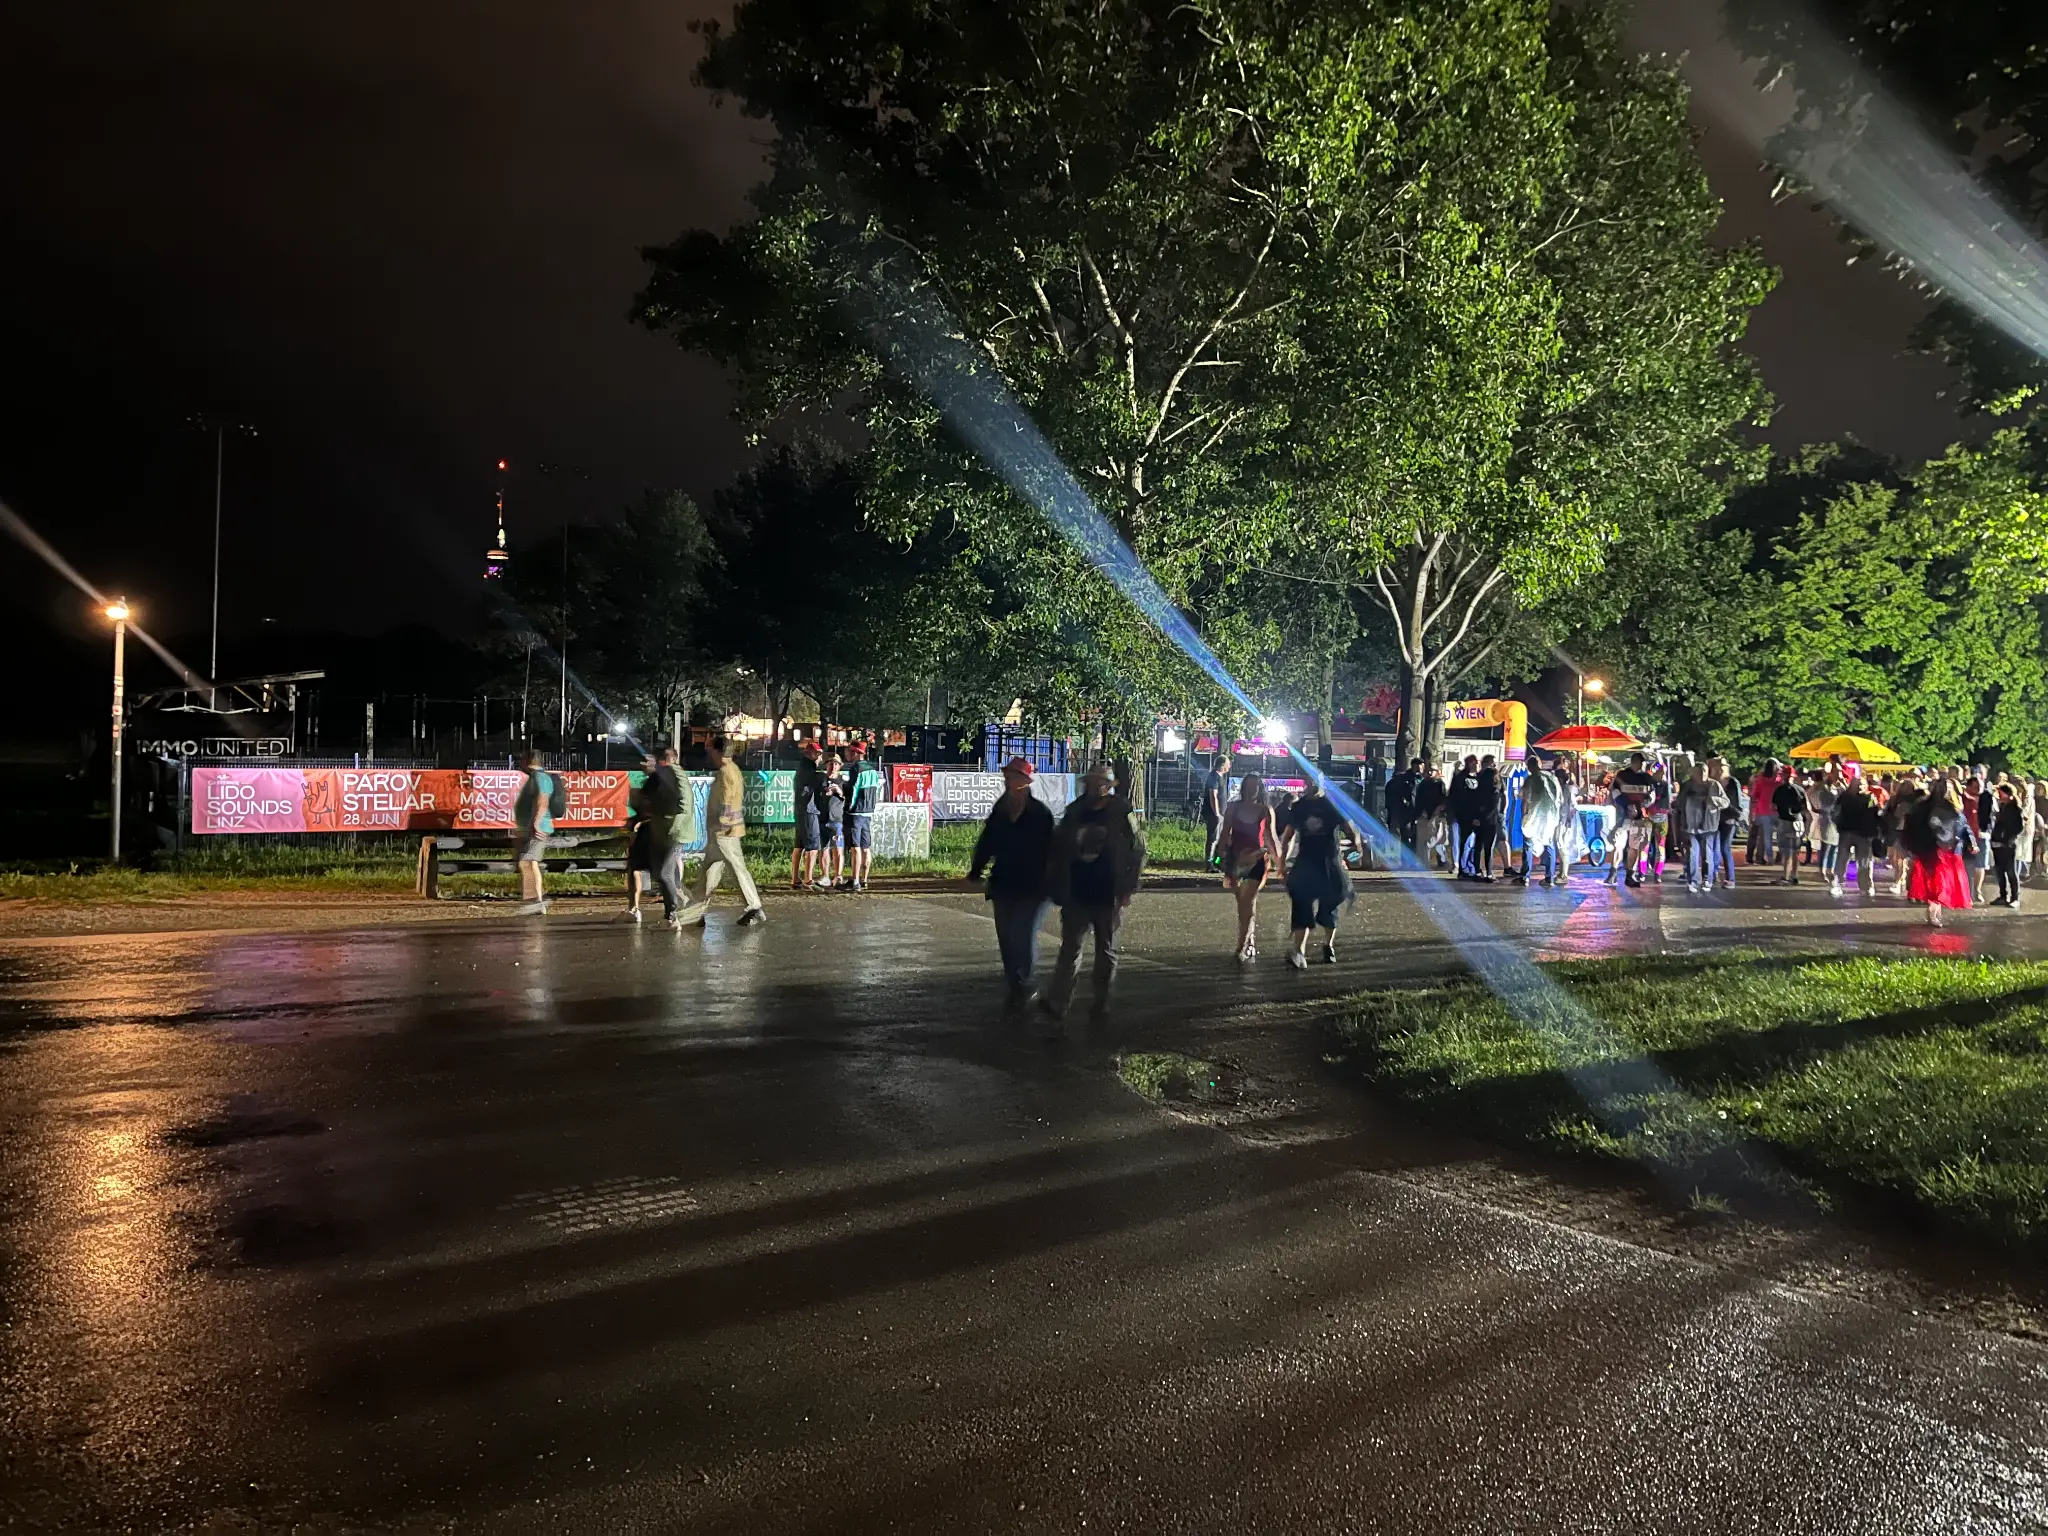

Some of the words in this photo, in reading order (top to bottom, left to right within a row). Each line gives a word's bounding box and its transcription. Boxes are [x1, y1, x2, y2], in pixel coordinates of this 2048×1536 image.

[1455, 707, 1486, 720] WIEN
[136, 740, 199, 756] IMMO
[206, 741, 285, 756] UNITED
[343, 774, 422, 792] PAROV
[459, 775, 520, 789] HOZIER
[947, 776, 969, 787] THE
[207, 785, 256, 800] LIDO
[460, 792, 509, 806] MARC
[947, 789, 995, 801] EDITORS
[207, 800, 293, 815] SOUNDS
[343, 793, 436, 811] STELAR
[947, 802, 970, 814] THE
[206, 816, 246, 829] LINZ
[343, 814, 363, 826] 28.
[366, 813, 399, 825] JUNI
